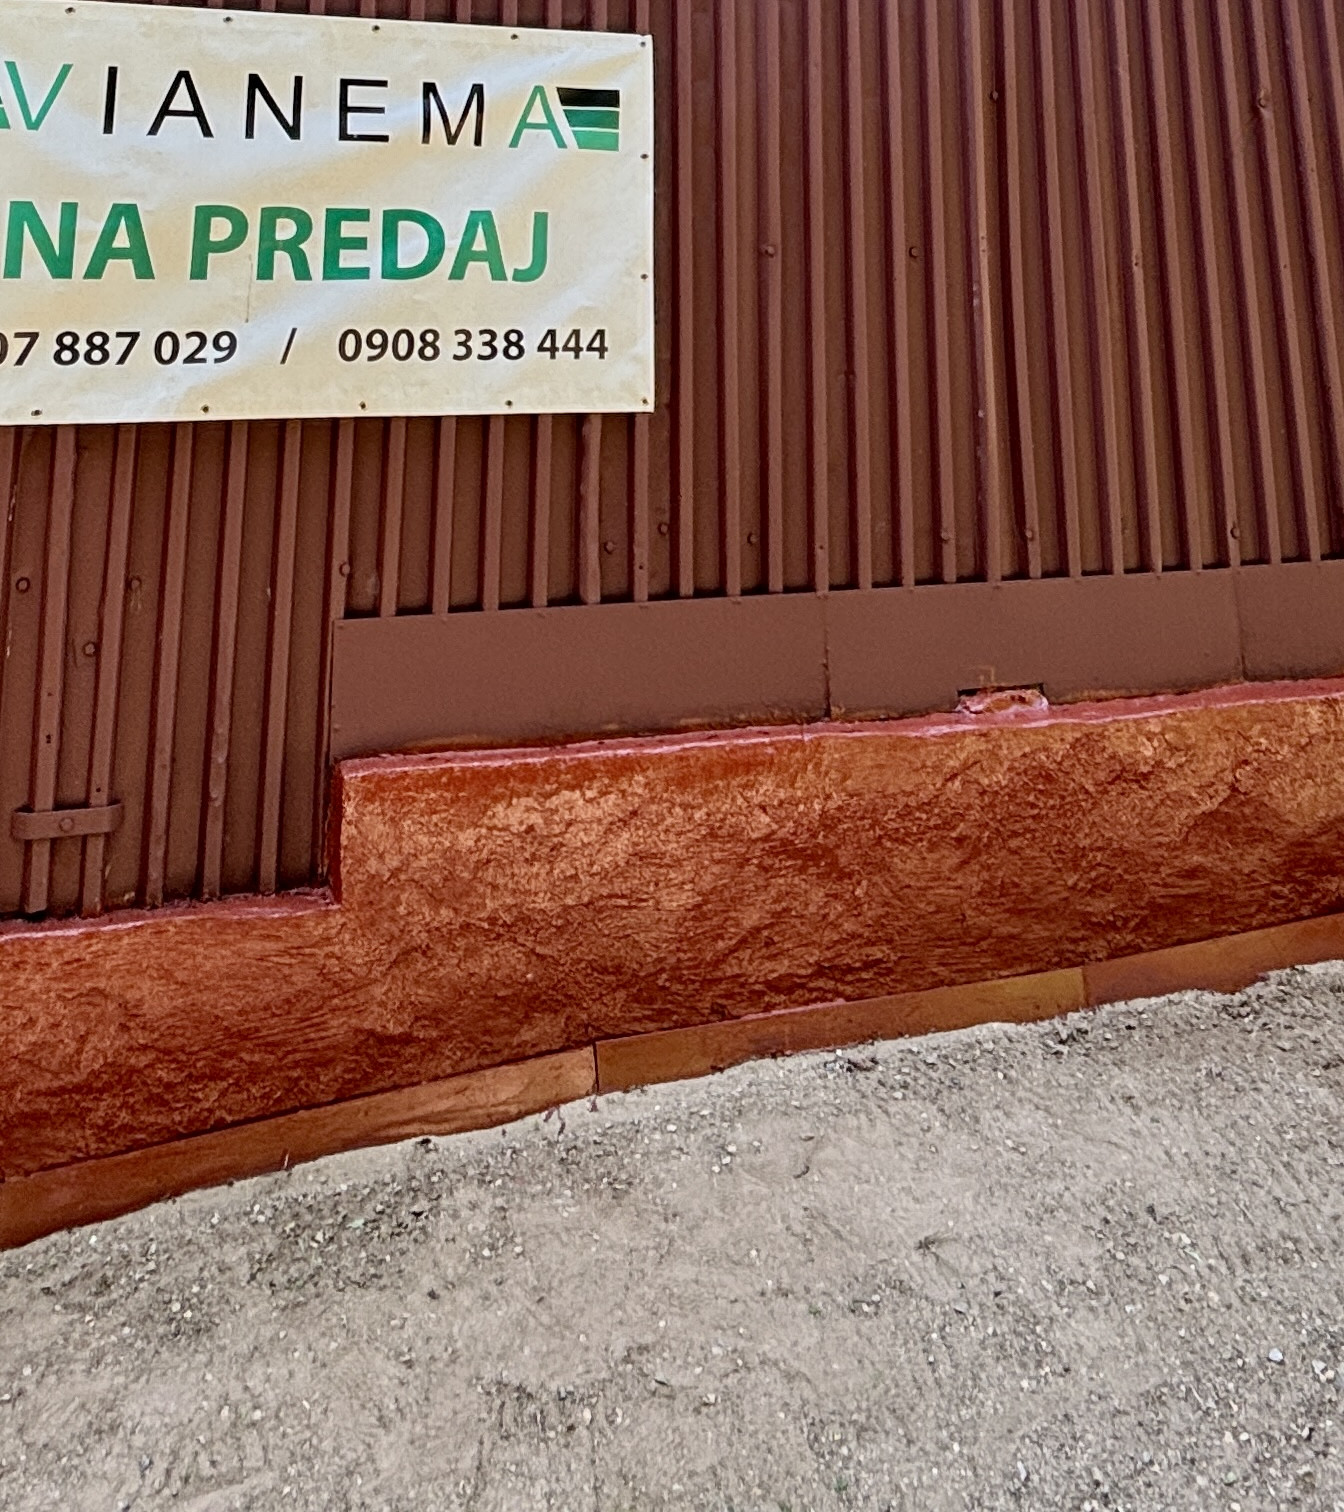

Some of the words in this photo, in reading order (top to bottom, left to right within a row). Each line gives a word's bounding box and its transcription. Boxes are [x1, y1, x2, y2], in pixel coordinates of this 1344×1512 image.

[4, 60, 567, 150] VIANEMA
[3, 200, 157, 281] NA
[189, 204, 550, 284] PREDAJ
[53, 331, 141, 367] 887
[154, 331, 239, 367] 029
[338, 328, 441, 363] 0908
[453, 329, 526, 362] 338
[537, 328, 610, 361] 444
